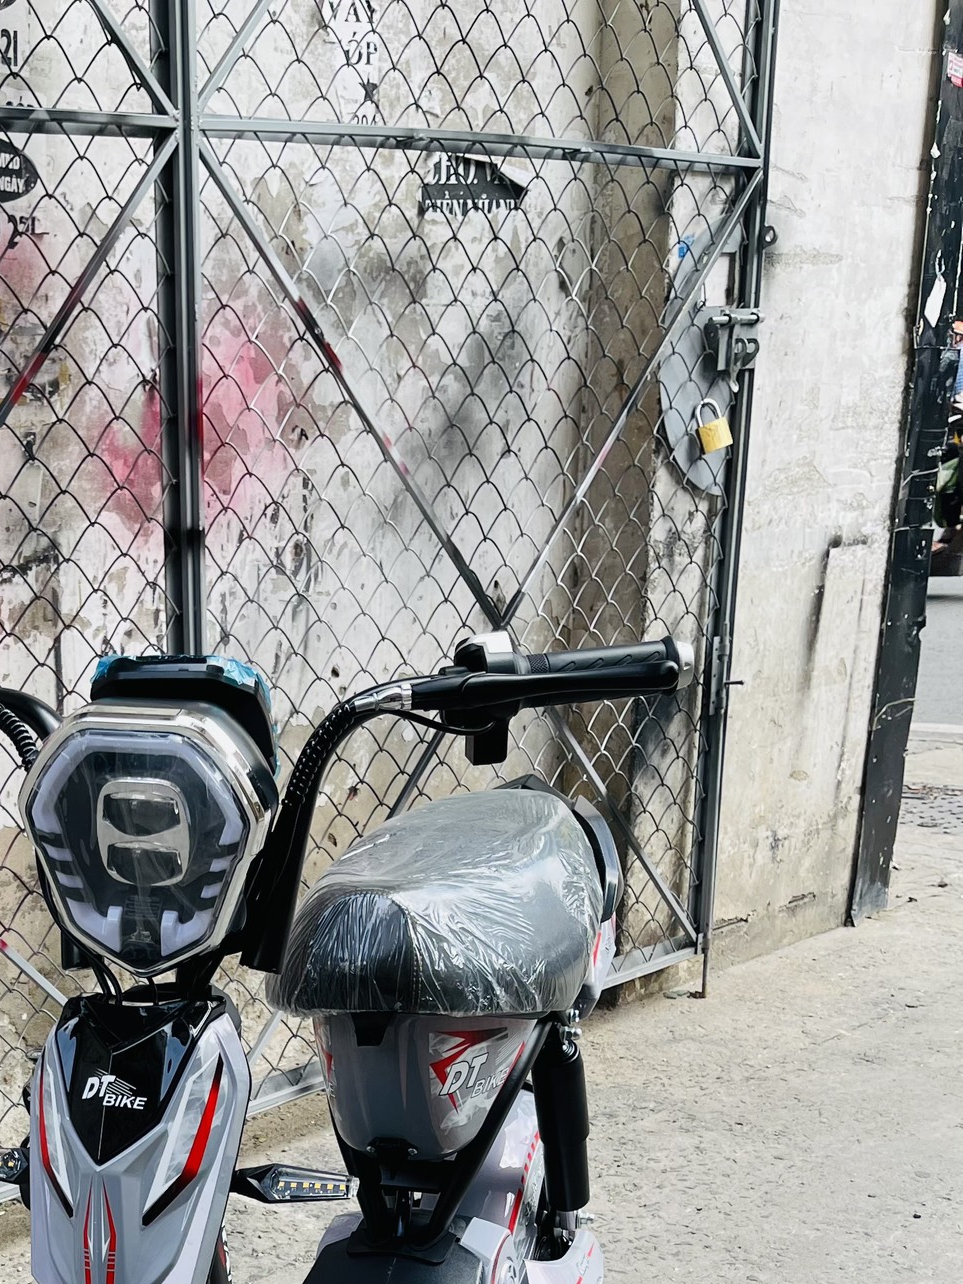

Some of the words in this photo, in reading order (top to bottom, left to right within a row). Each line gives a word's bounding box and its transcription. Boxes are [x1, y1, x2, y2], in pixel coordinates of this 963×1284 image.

[81, 1074, 117, 1100] DT
[102, 1093, 148, 1110] BIKE
[439, 1052, 490, 1097] DT
[471, 1067, 514, 1099] BIKE
